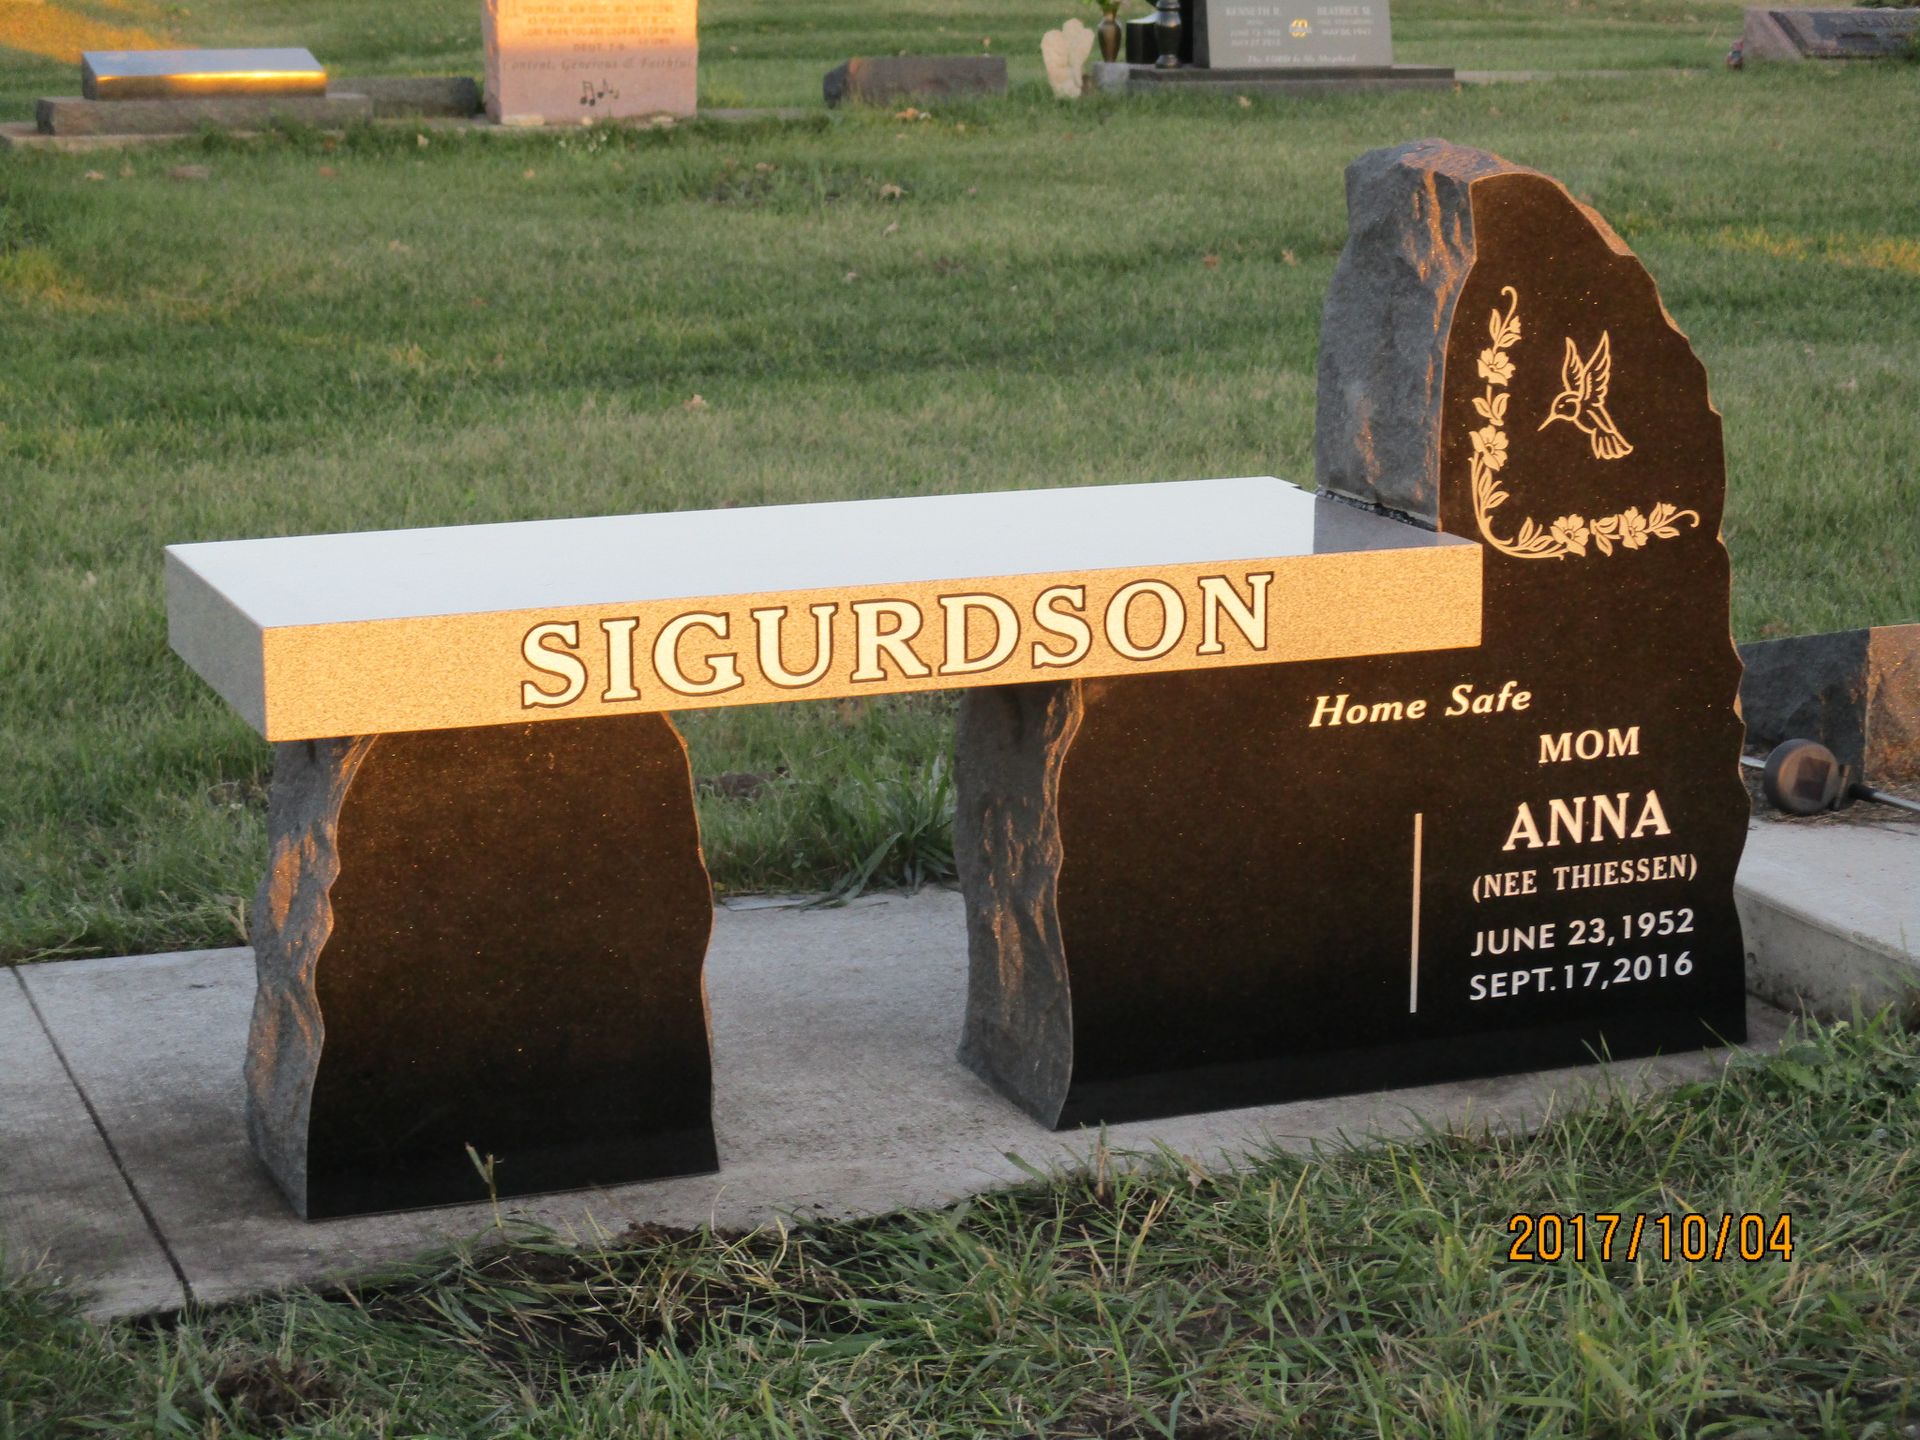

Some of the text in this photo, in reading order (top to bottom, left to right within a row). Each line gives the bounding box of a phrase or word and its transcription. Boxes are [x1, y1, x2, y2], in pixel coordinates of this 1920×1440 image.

[519, 569, 1274, 709] SIGURDSON
[1309, 680, 1532, 728] Home Safe
[1538, 726, 1641, 764] MOM
[1502, 789, 1672, 852] ANNA
[1472, 853, 1698, 904] (NEE THIESSEN)
[1470, 922, 1556, 958] JUNE
